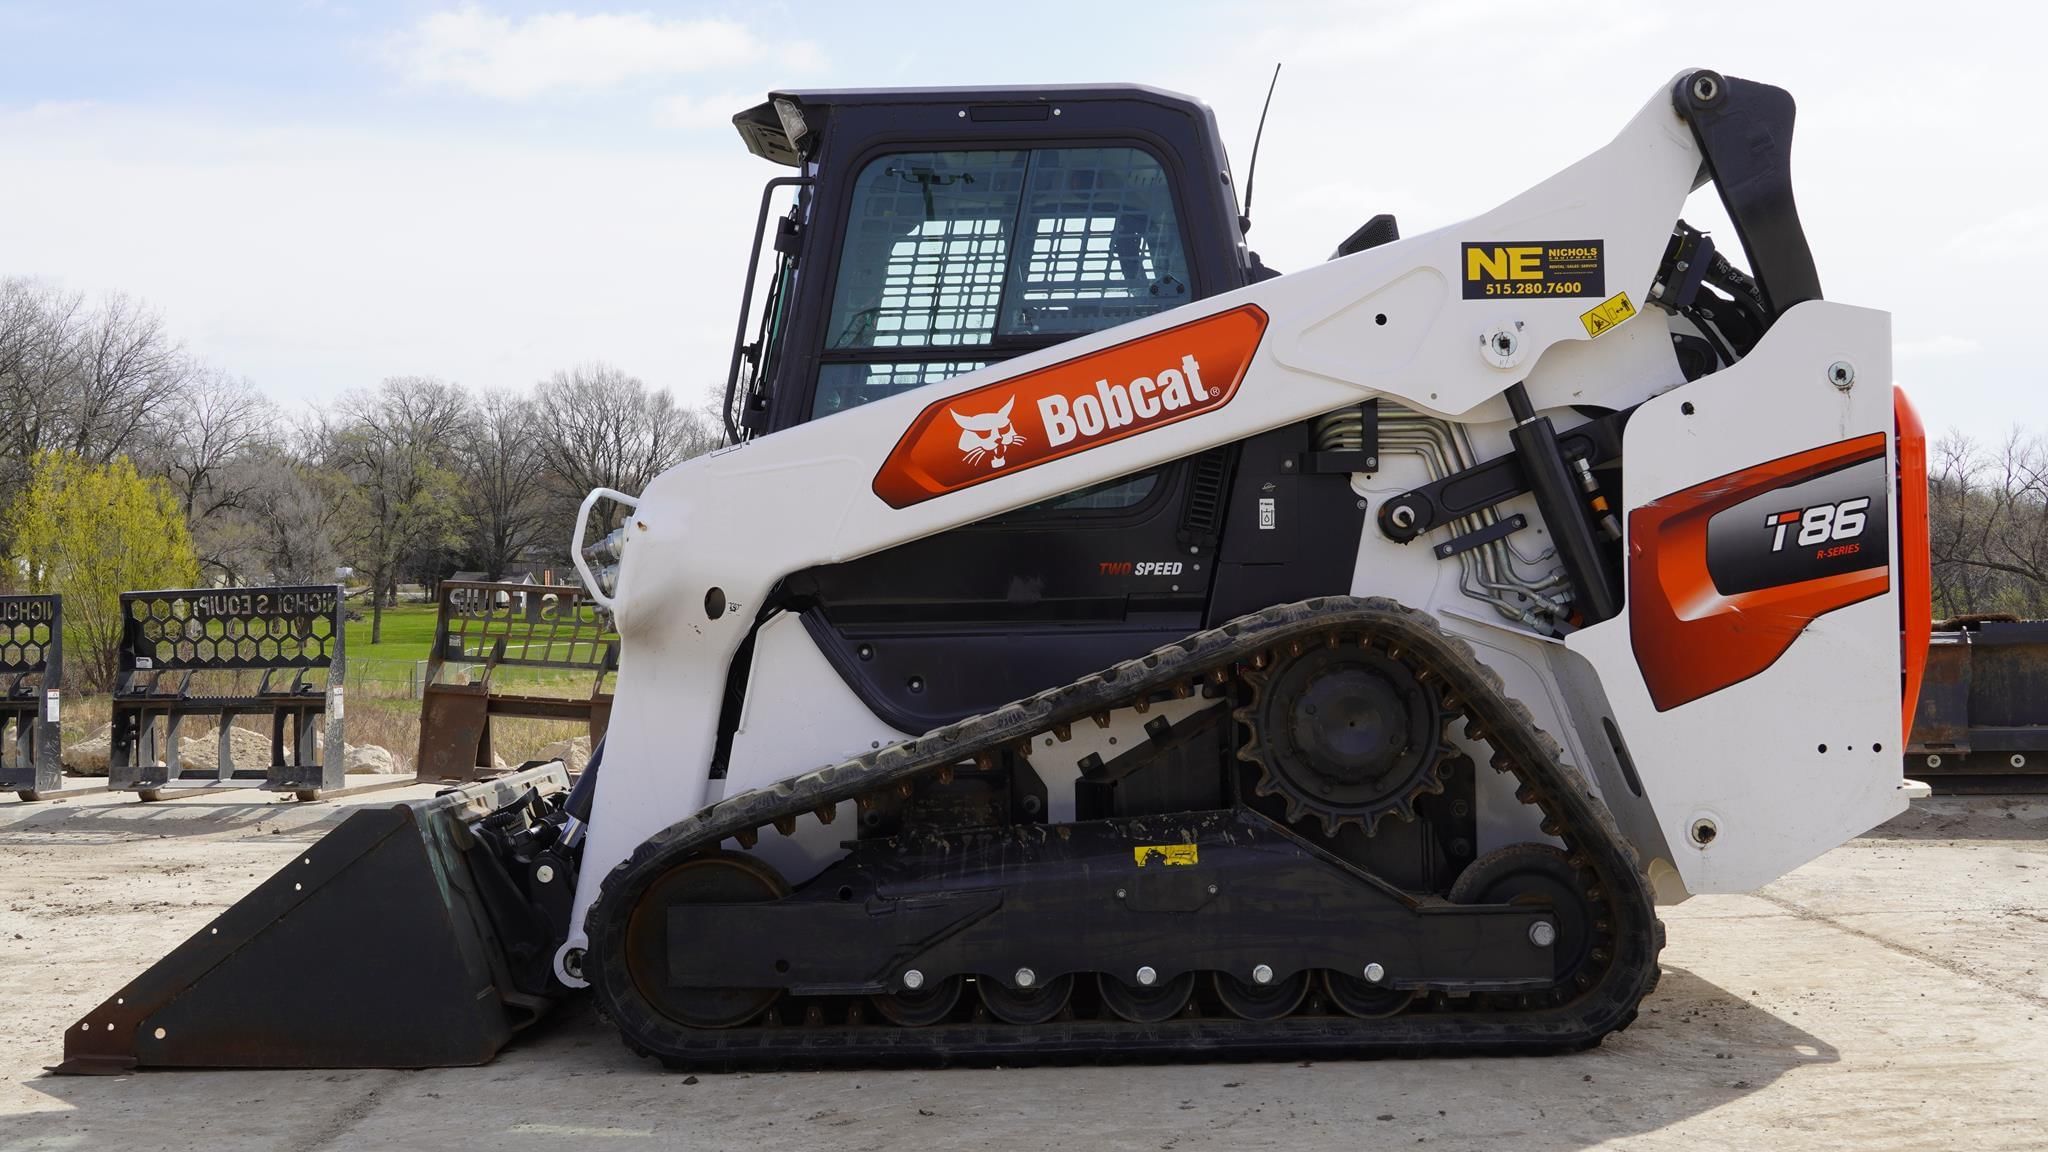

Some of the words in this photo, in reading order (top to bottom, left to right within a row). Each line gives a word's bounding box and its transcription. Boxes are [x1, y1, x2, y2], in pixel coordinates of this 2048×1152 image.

[1548, 248, 1598, 256] NICHOLS
[1467, 247, 1544, 281] NE
[1485, 281, 1582, 295] 515.280.7600
[1036, 354, 1208, 448] Bobcat
[1766, 497, 1870, 552] T86
[1816, 543, 1861, 560] R-SERIES
[1099, 562, 1132, 575] TWO
[1135, 562, 1183, 575] SPEED
